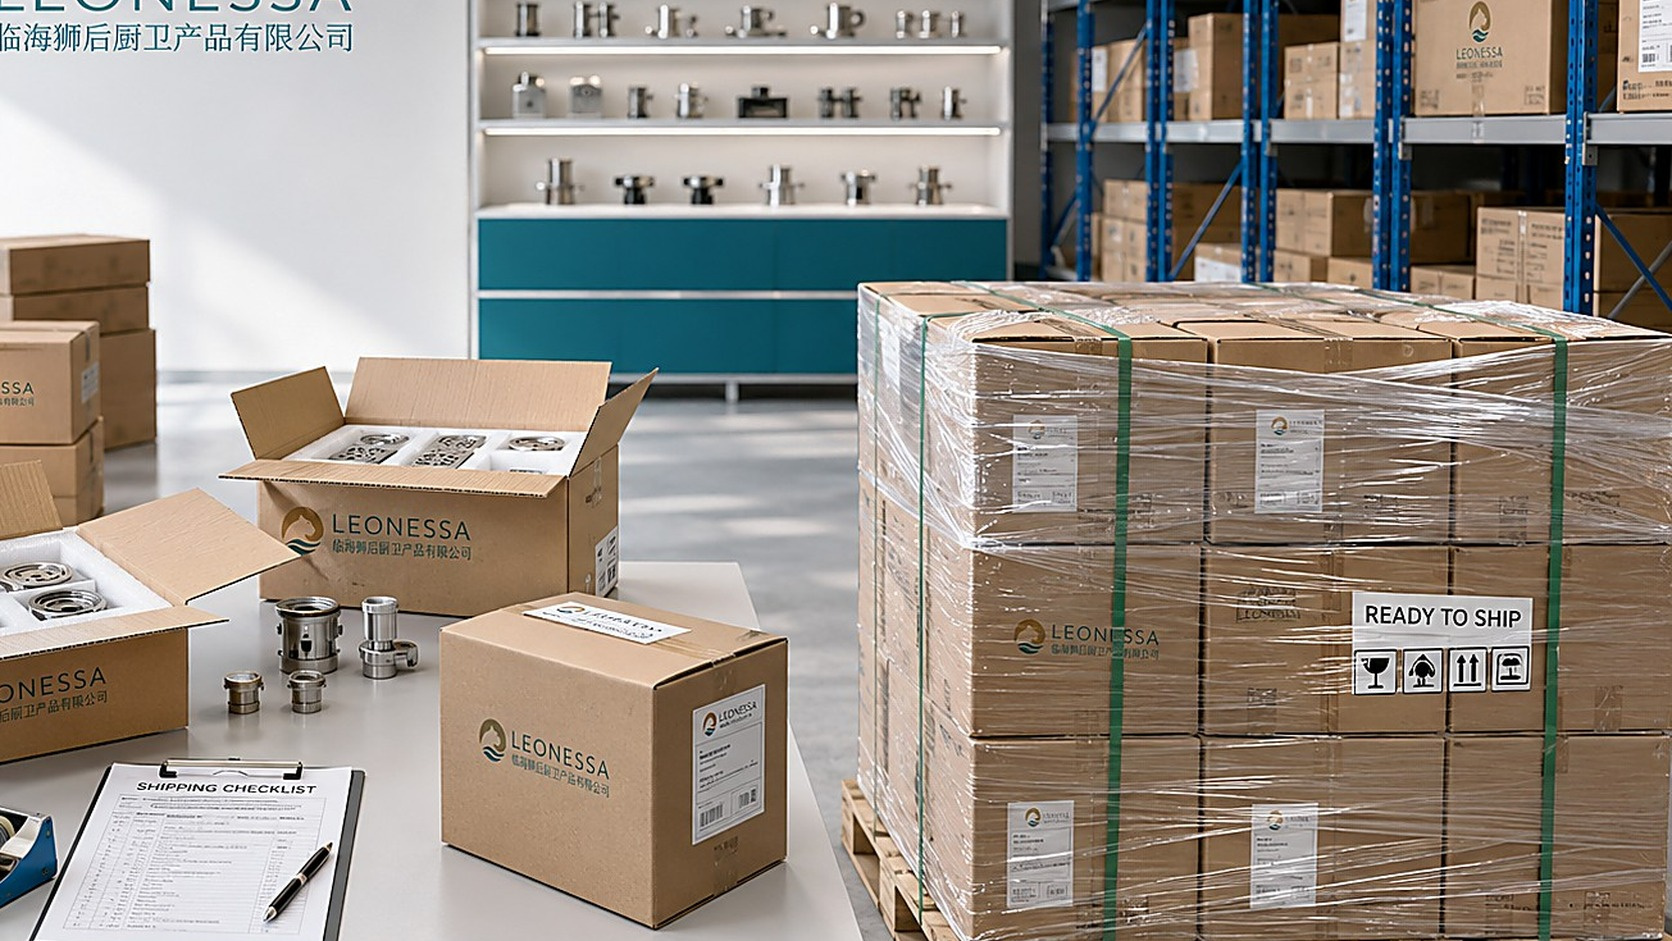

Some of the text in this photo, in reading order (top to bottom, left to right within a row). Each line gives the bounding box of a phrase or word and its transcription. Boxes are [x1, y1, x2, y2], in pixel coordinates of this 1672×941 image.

[0, 23, 353, 52] 临海狮后厨卫产品有限公司
[1456, 47, 1503, 60] LEONESSA
[1, 381, 34, 395] SSA
[333, 514, 470, 541] LEONESSA
[1365, 605, 1522, 628] READY TO SHIP
[1051, 625, 1159, 646] LEONSSA
[511, 730, 610, 780] LEONESSA
[136, 782, 317, 794] SHIPPING CHECKLIST
